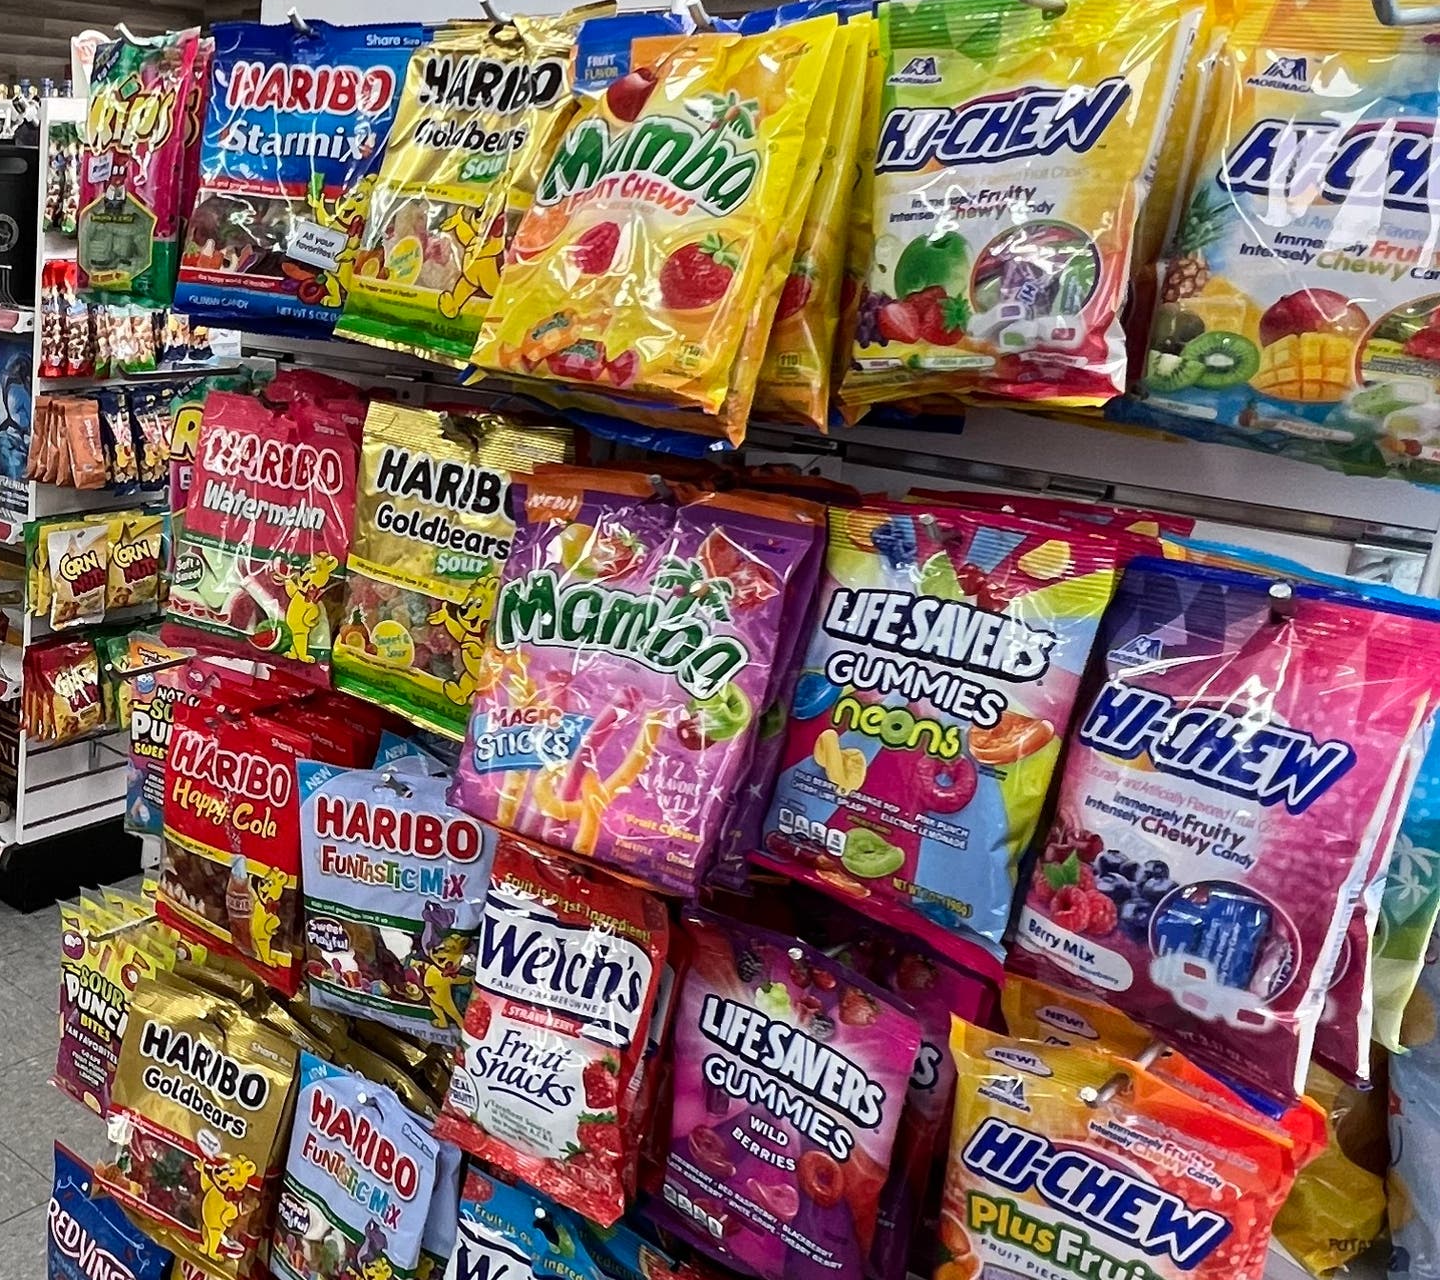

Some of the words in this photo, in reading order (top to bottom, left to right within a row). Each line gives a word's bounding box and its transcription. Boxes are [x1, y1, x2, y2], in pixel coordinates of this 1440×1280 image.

[225, 62, 397, 116] HARIBO
[419, 54, 562, 111] HARIBO
[587, 54, 617, 67] FRUIT
[227, 120, 366, 161] Starmix
[875, 76, 1131, 175] HI-CHEW
[537, 116, 761, 216] Mambo
[620, 173, 696, 218] CHEWS
[1240, 243, 1316, 266] Intensely
[1316, 251, 1410, 282] Chewy
[202, 425, 344, 496] HARIBO
[376, 448, 515, 521] HARIB
[204, 480, 326, 531] Watermelon
[376, 504, 511, 561] Goldbears
[60, 551, 100, 582] CORN
[112, 540, 151, 570] CORN
[498, 569, 750, 699] Mambo
[902, 595, 1057, 682] SAVERS
[157, 686, 185, 704] NOT
[825, 650, 1008, 728] GUMMIES
[477, 729, 572, 762] STICKS
[831, 697, 961, 760] neons
[1080, 683, 1357, 815] HI-CHEW
[171, 730, 292, 808] HARIBO
[307, 766, 334, 789] NEW
[315, 796, 484, 863] HARIBO
[1085, 795, 1141, 826] Intensely
[1141, 815, 1211, 856] Chewy
[1212, 844, 1255, 870] Candy
[1113, 791, 1183, 825] Immensely
[1182, 813, 1245, 850] Fruity
[308, 929, 349, 953] Playful
[480, 915, 643, 1016] Welch's
[1027, 918, 1060, 951] Berry
[1062, 933, 1096, 965] Mix
[79, 964, 125, 1011] SOUR
[80, 1012, 112, 1043] BITES
[493, 1029, 571, 1072] Fruit
[140, 1019, 267, 1112] HARIBO
[470, 1045, 577, 1107] Snacks
[699, 994, 763, 1062] LIFE
[760, 1019, 887, 1129] SAVERS
[994, 1048, 1037, 1067] NEW!
[142, 1067, 248, 1139] Goldbears
[703, 1054, 856, 1162] GUMMIES
[749, 1116, 789, 1147] WILD
[310, 1089, 419, 1202] HARIBO
[732, 1126, 796, 1172] BERRIES
[474, 1203, 503, 1229] Fruit
[962, 1117, 1233, 1272] HI-CHEW
[981, 1236, 1022, 1266] FRUIT
